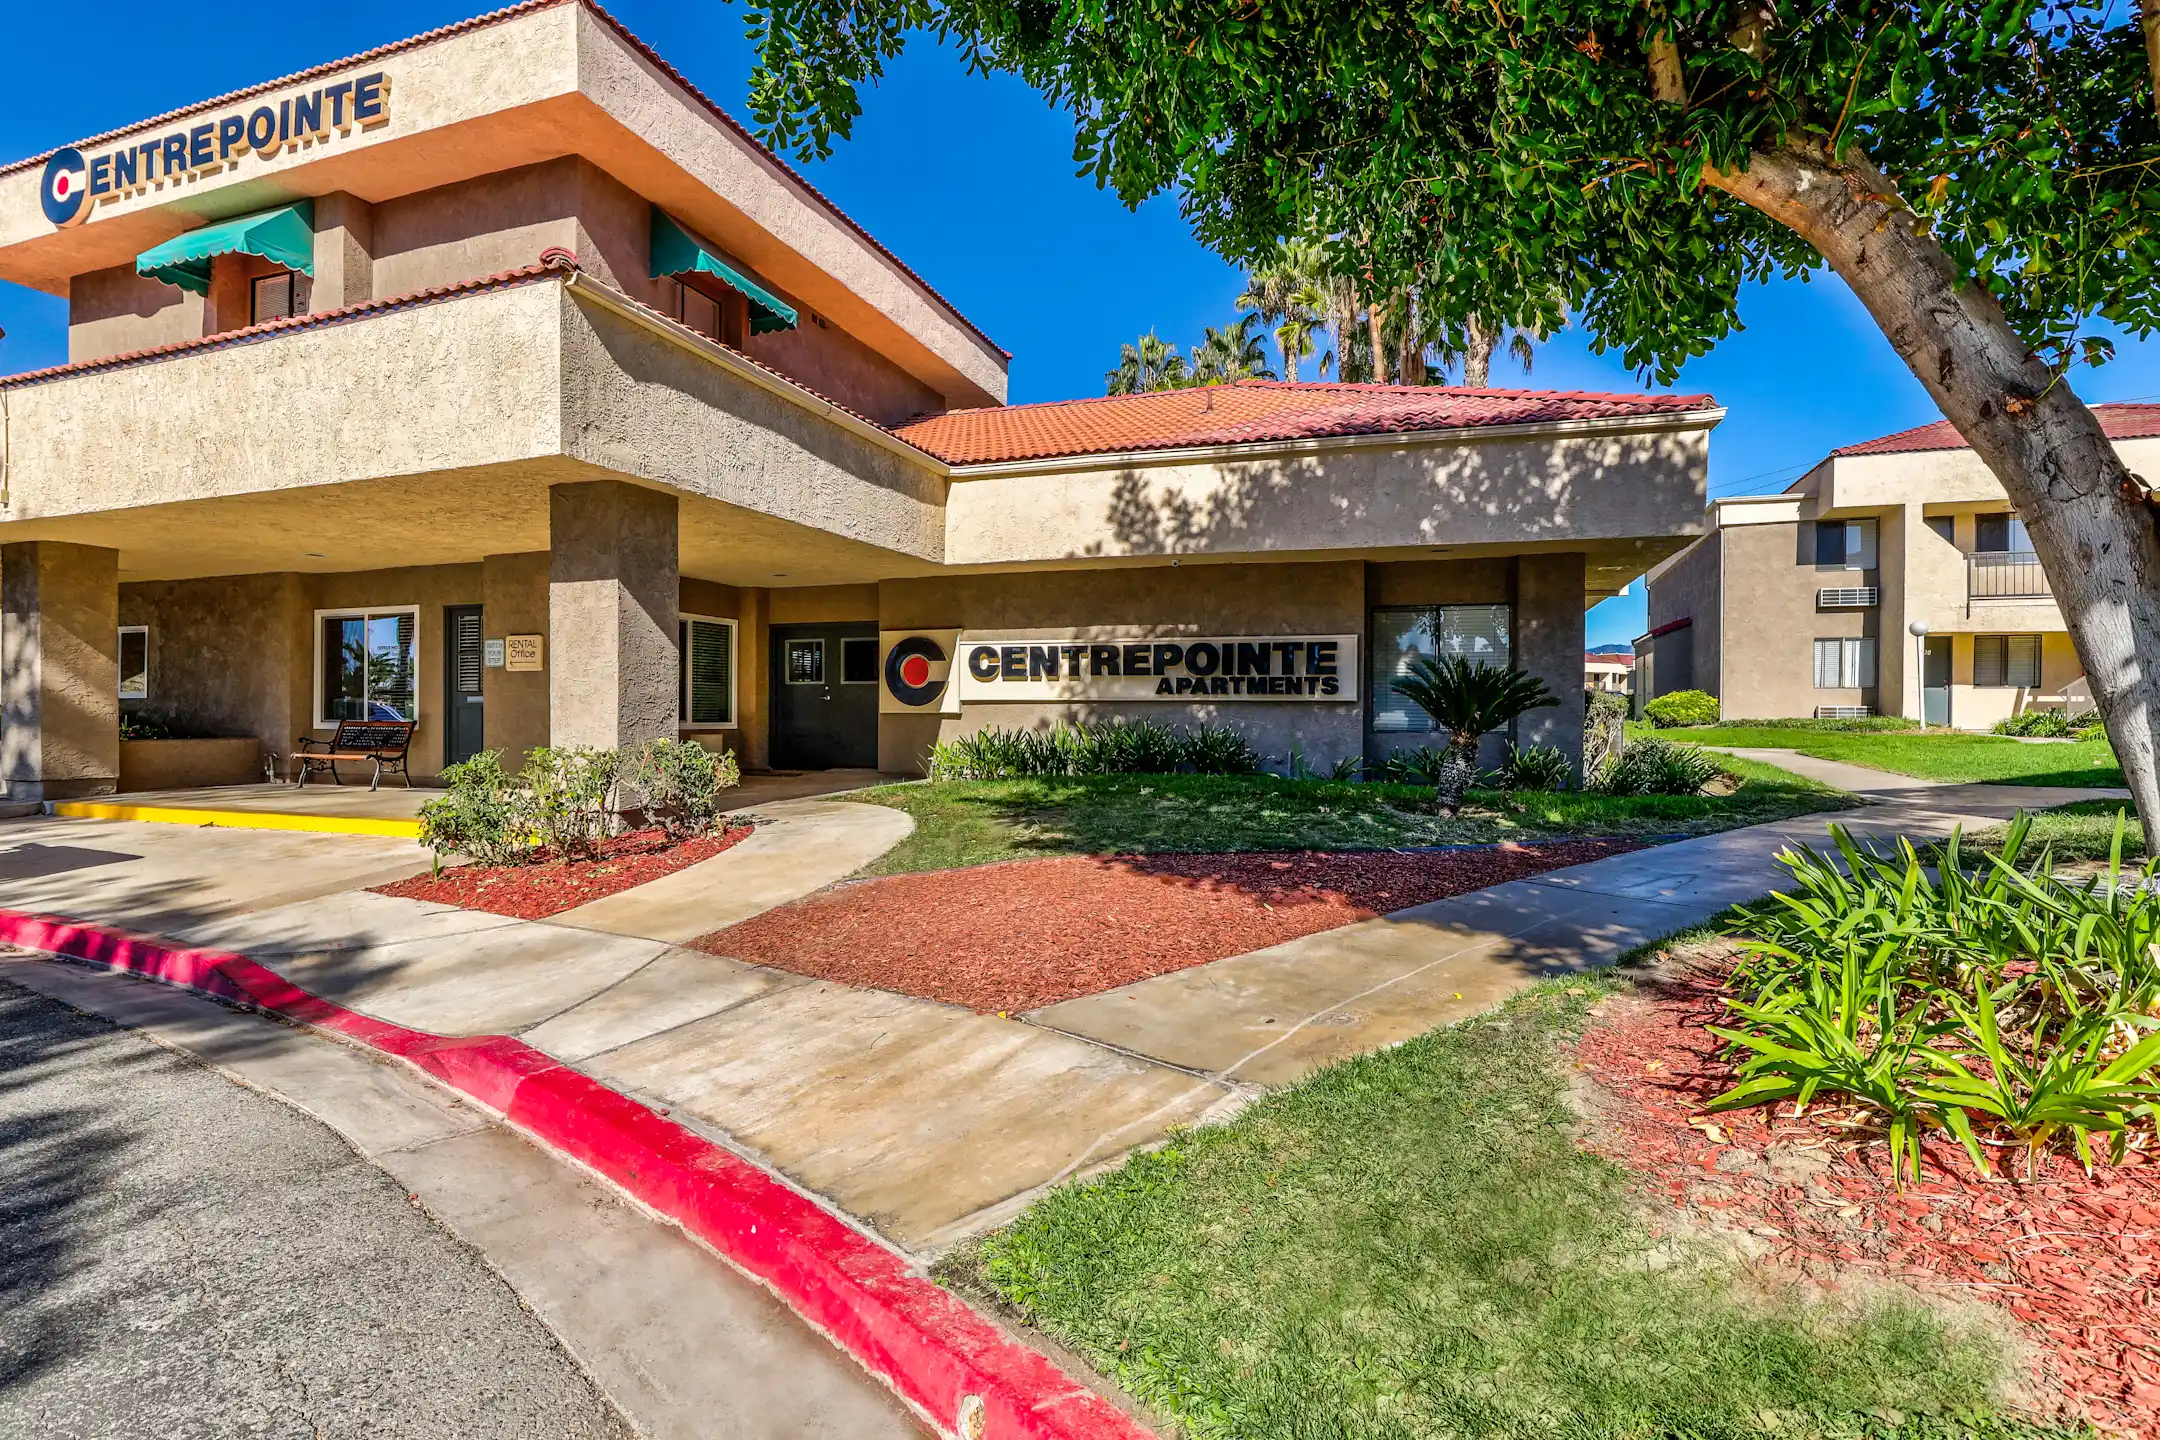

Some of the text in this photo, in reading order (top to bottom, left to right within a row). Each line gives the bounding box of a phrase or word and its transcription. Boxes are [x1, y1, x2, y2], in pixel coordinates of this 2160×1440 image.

[41, 72, 384, 226] CENTREPOINTE
[509, 640, 537, 649] RENTAL
[511, 649, 536, 658] Office
[968, 641, 1338, 682] CENTREPOINTE
[1154, 676, 1340, 695] APARTMENTS
